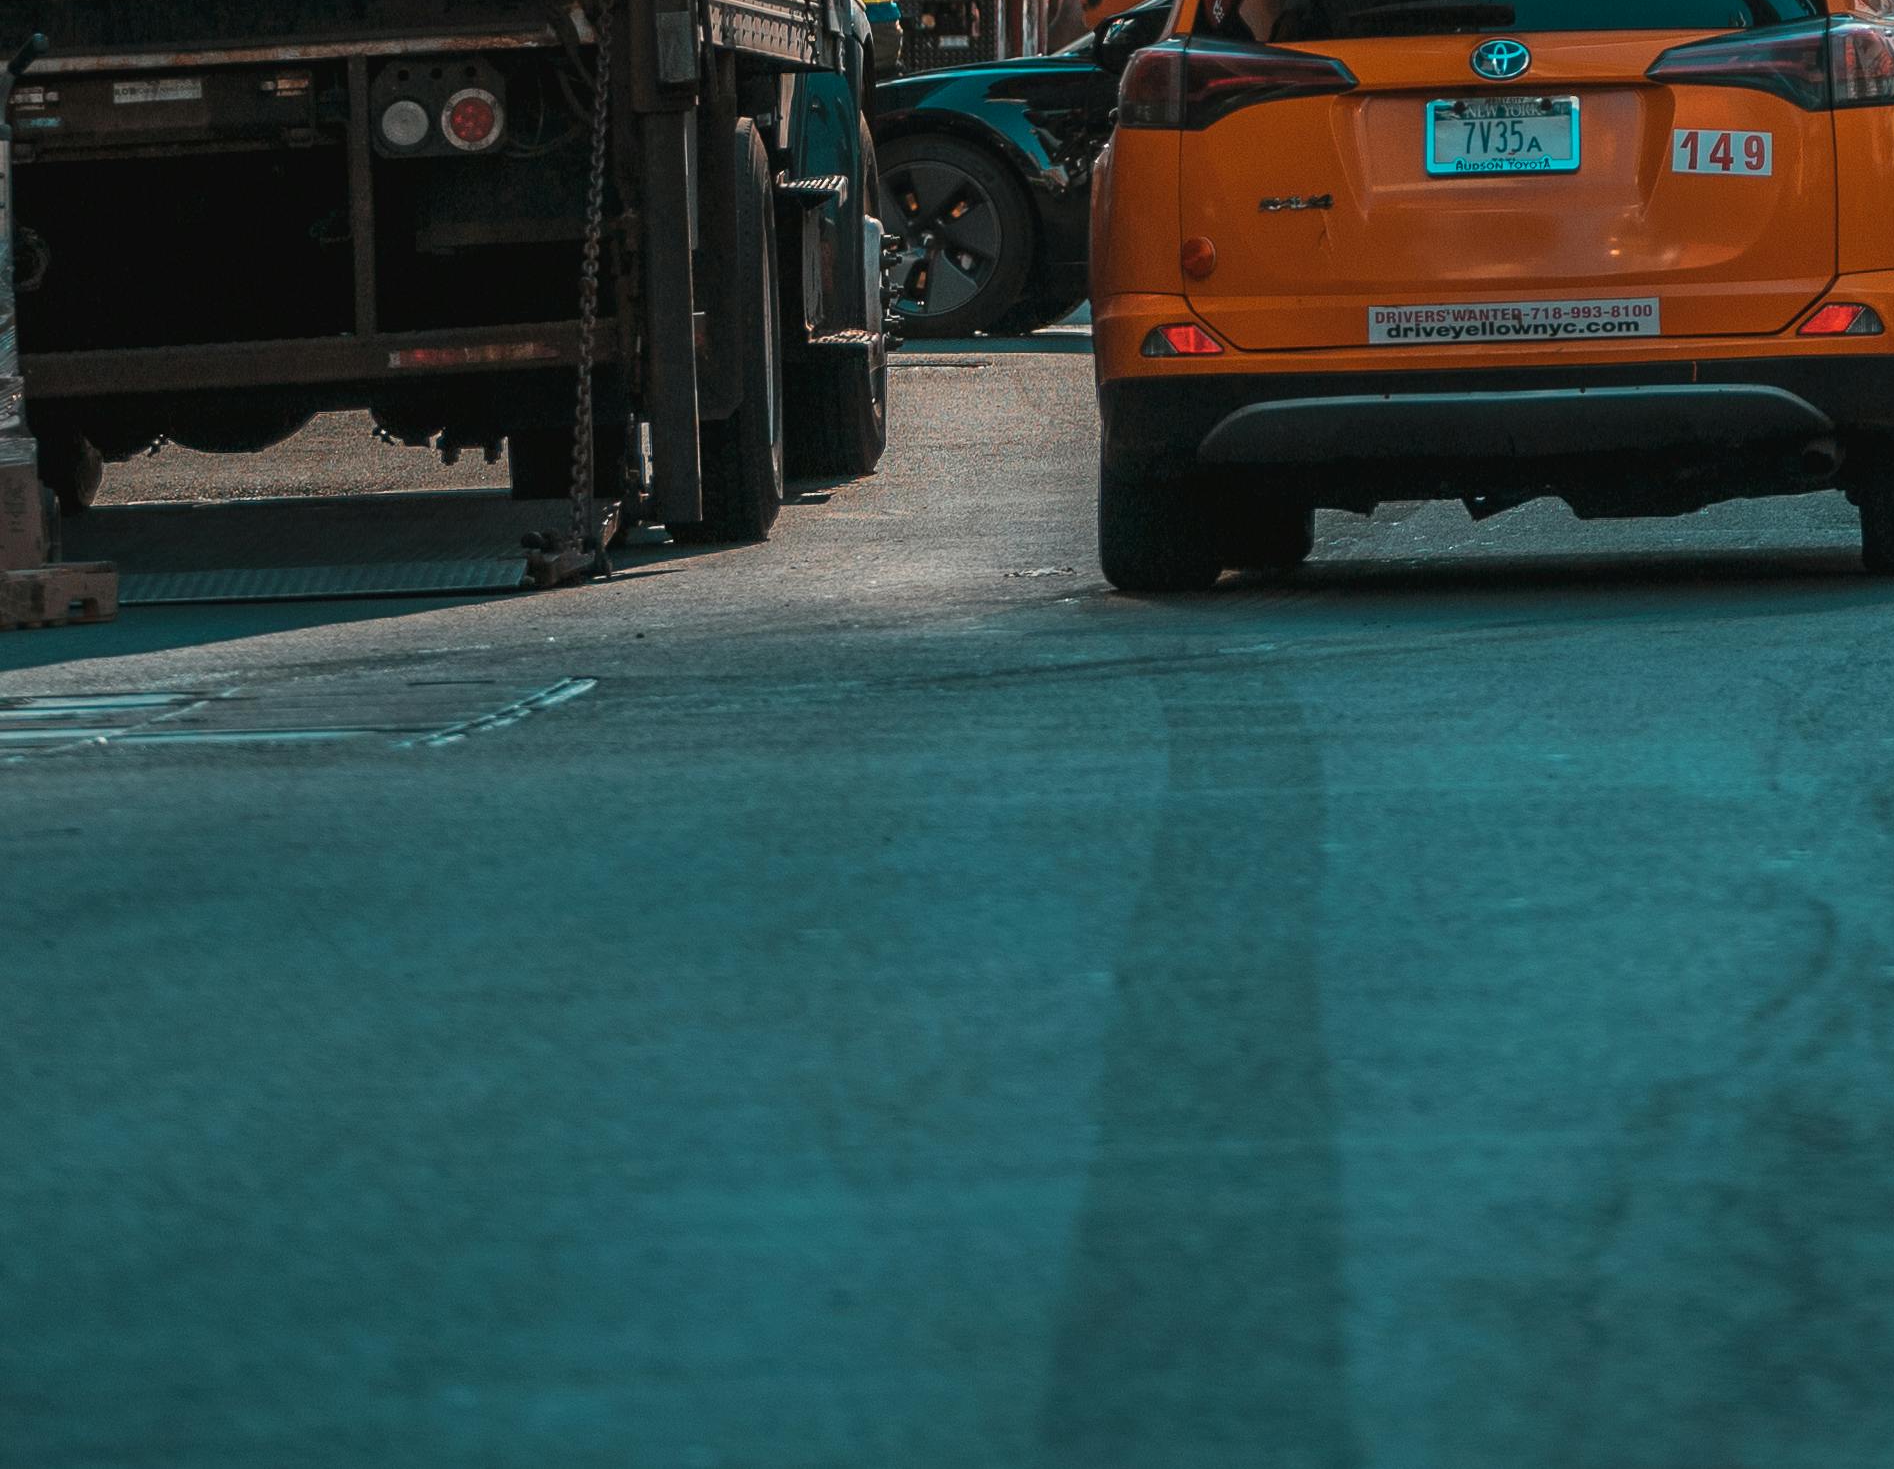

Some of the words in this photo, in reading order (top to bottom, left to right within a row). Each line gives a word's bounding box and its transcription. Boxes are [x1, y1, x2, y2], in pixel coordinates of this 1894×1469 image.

[1466, 104, 1498, 119] NEW
[1503, 103, 1543, 118] YORK
[1679, 131, 1767, 171] 149
[1509, 159, 1551, 170] TOYOTA
[1386, 319, 1640, 340] driveyellownyc.com
